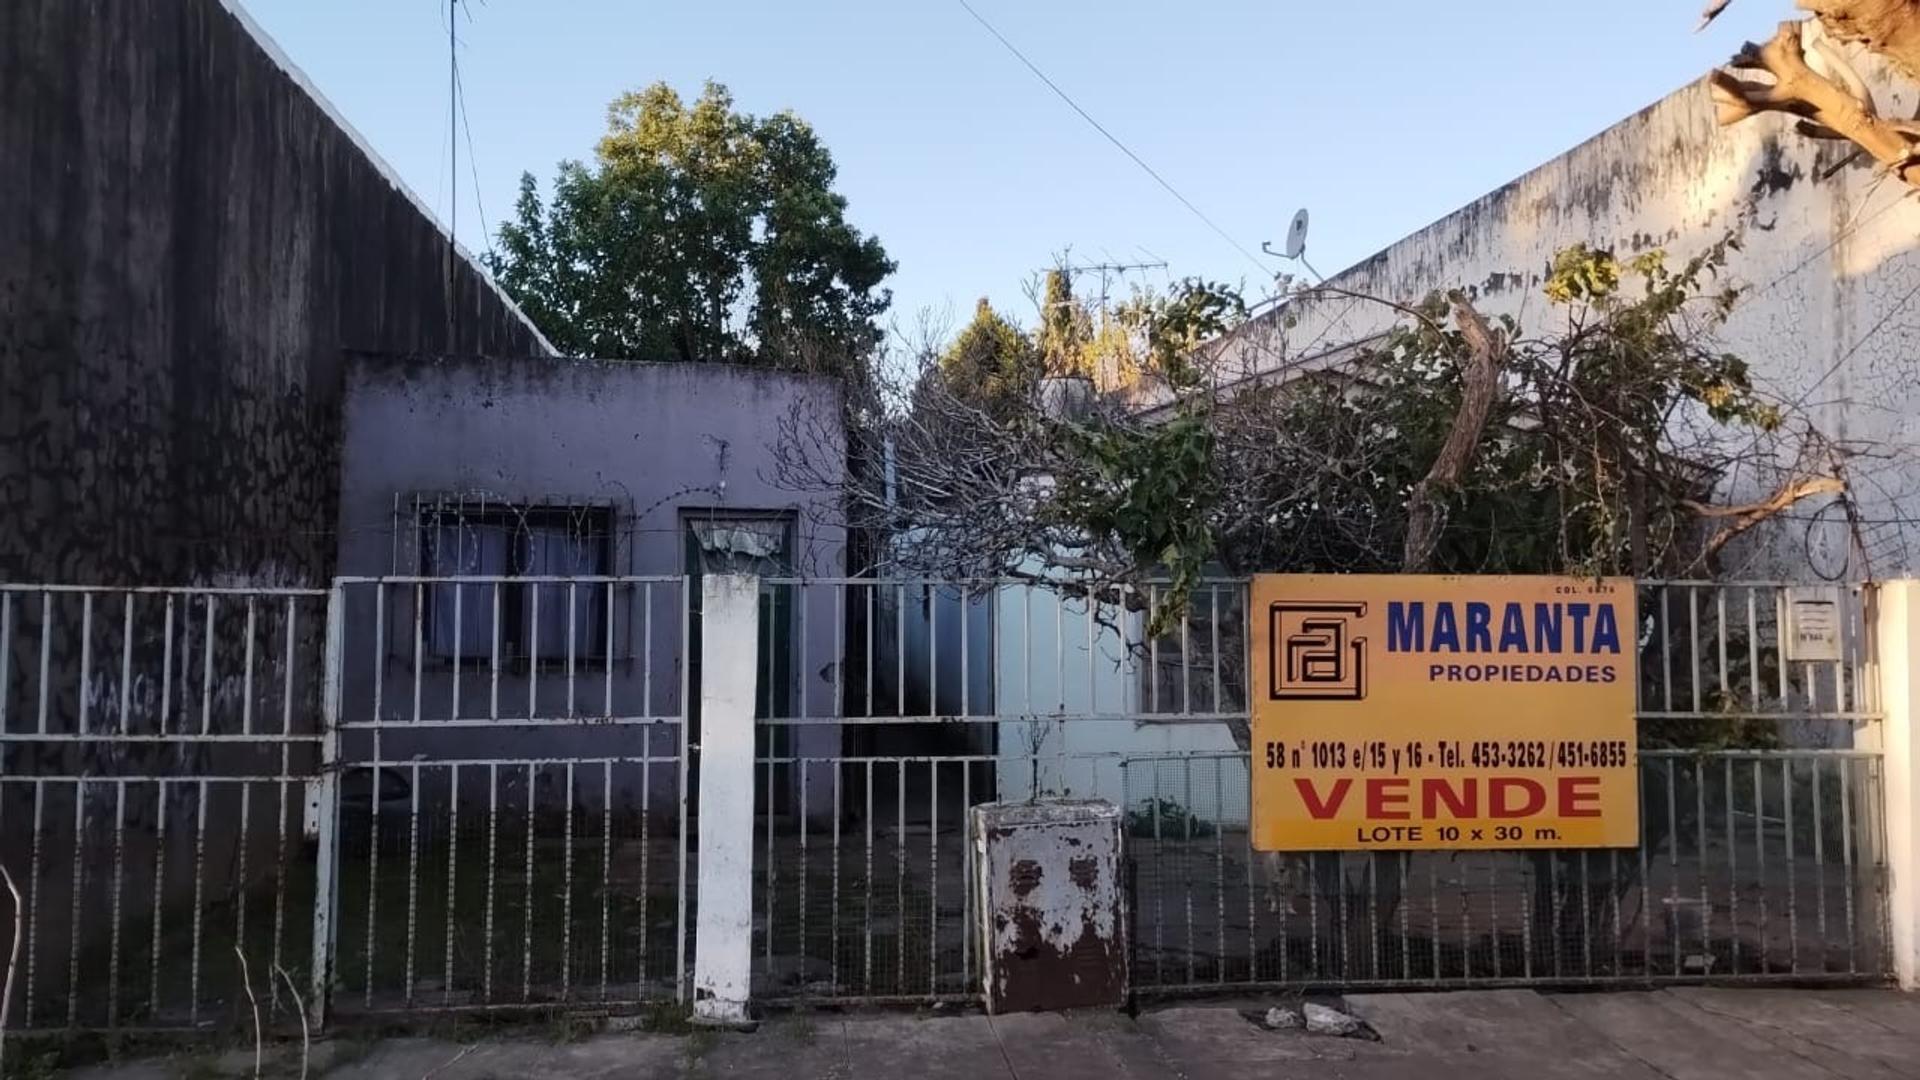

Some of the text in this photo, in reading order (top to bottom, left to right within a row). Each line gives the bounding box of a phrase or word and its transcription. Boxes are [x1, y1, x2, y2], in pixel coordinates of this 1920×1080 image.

[1387, 601, 1621, 655] MARANTA
[1429, 664, 1616, 683] PROPIEDADES
[1266, 741, 1285, 769] 58
[1311, 741, 1346, 769] 1013
[1392, 748, 1401, 776] y
[1405, 741, 1423, 769] 16
[1438, 740, 1466, 769] Tel.
[1293, 776, 1602, 820] VENDE
[1357, 826, 1562, 843] LOTE 10 x 30 m.
